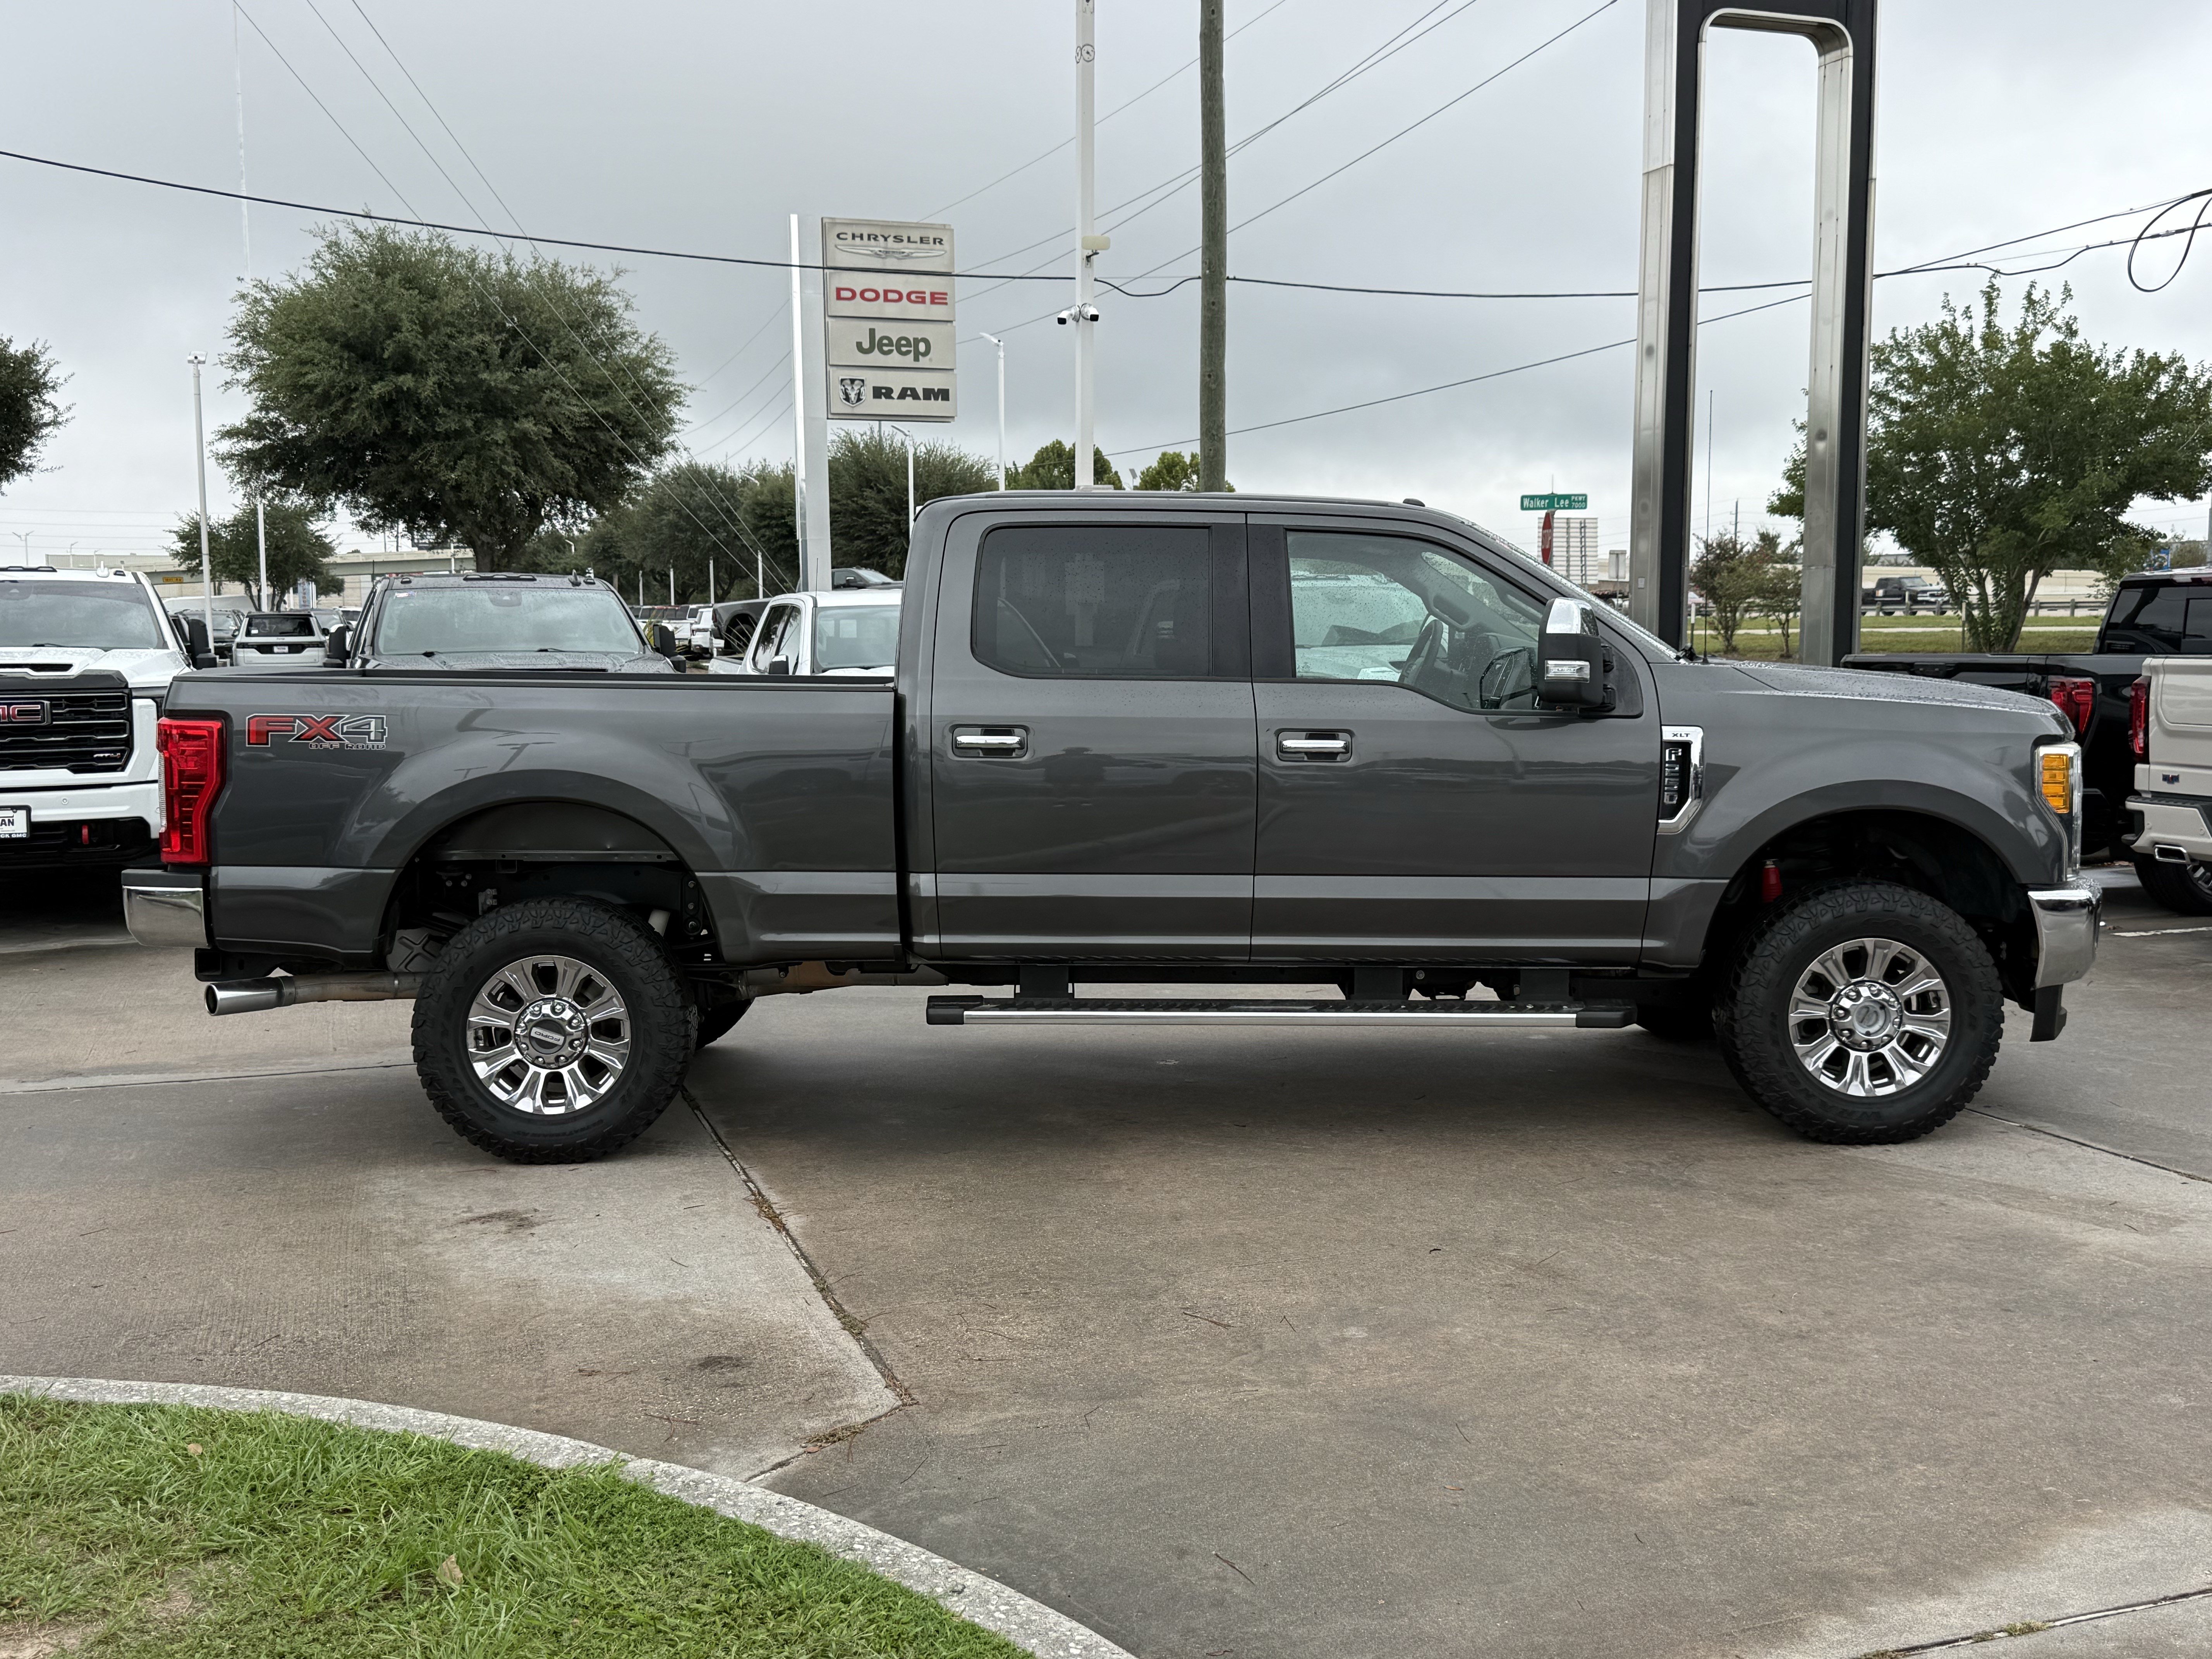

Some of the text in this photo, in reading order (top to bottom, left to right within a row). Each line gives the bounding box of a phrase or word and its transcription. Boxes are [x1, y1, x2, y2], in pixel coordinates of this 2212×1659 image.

[836, 232, 945, 246] CHRYSLER
[835, 287, 948, 306] DODGE
[855, 328, 931, 362] Jeep
[872, 385, 950, 402] RAM
[1523, 497, 1569, 508] Walker Lee
[246, 713, 388, 747] FX4
[534, 1031, 560, 1042] FORD
